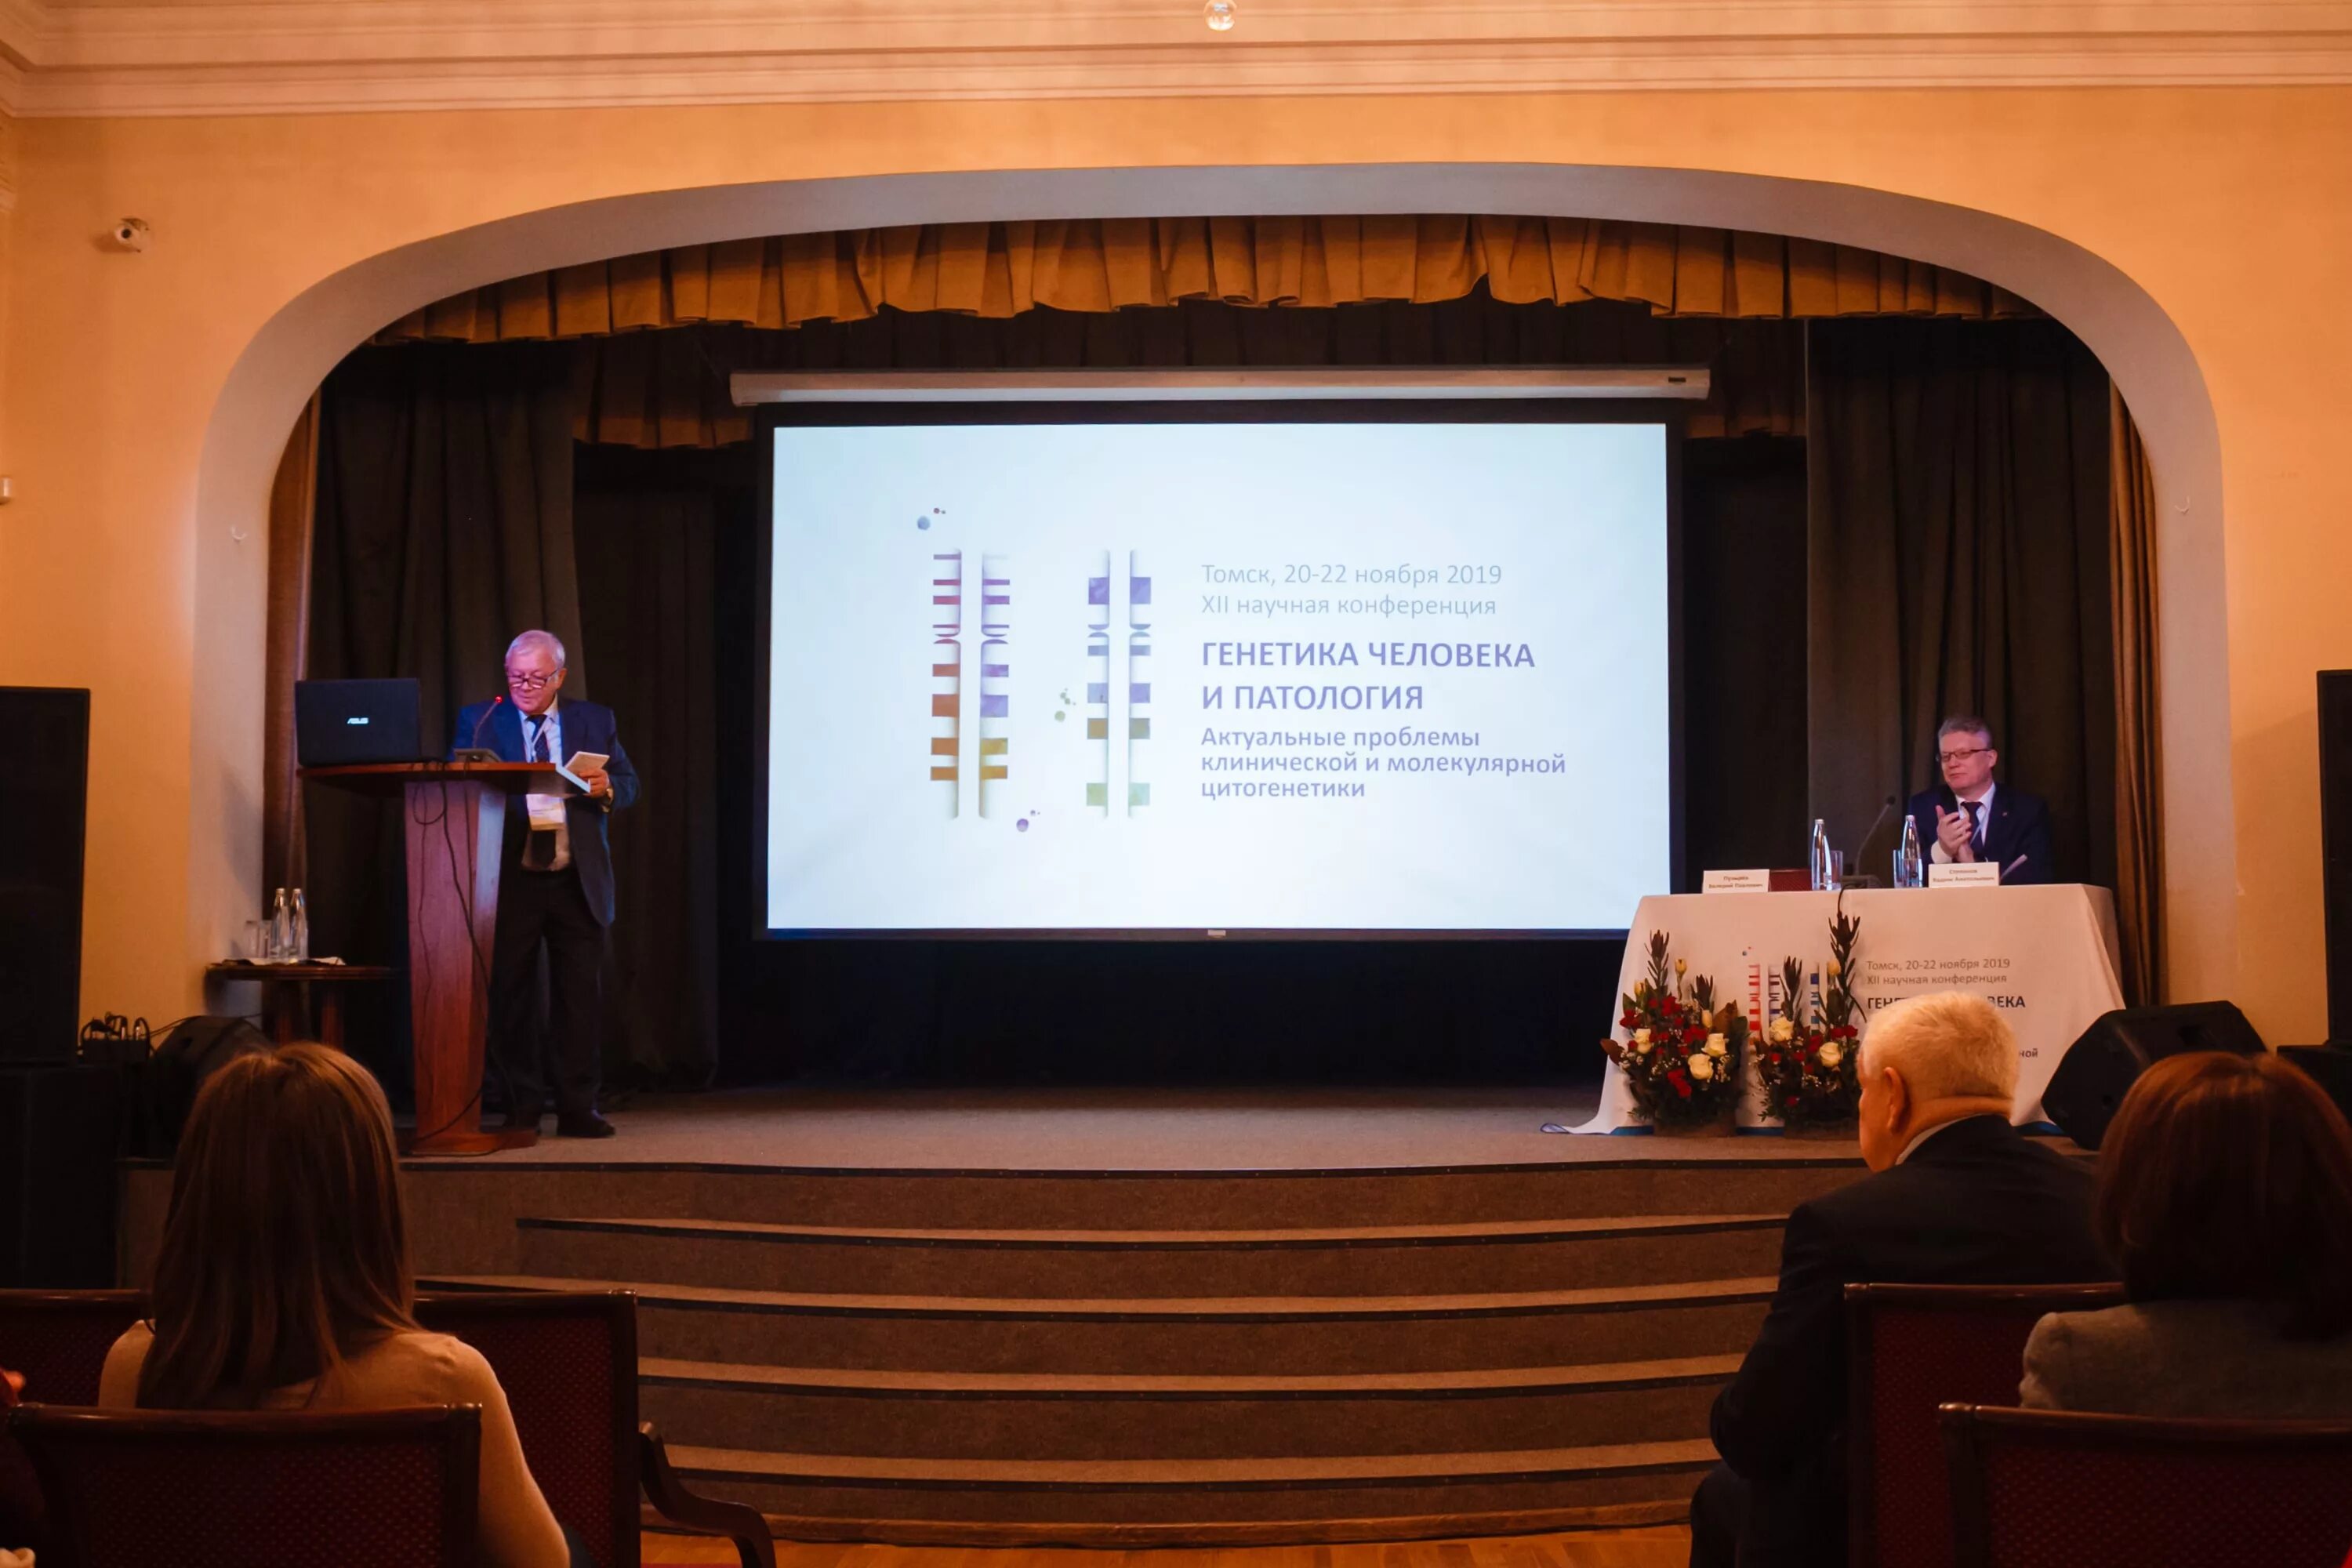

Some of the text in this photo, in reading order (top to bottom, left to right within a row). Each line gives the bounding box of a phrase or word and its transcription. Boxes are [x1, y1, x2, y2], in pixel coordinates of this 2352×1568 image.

[1201, 564, 1502, 588] Томск, 20-22 ноября 2019
[1237, 597, 1329, 618] научная
[1338, 594, 1496, 619] конференция
[1203, 643, 1535, 667] ГЕНЕТИКА ЧЕЛОВЕКА
[1203, 685, 1423, 709] И ПАТОЛОГИЯ
[1201, 727, 1479, 750] Актуальные проблемы
[1202, 752, 1566, 776] клинической и молекулярной
[1202, 782, 1365, 800] цитогенетики
[1867, 959, 2010, 971] Томск, 20-22 ноября 2019
[1883, 977, 1928, 985] научная
[1932, 974, 2006, 985] конференция
[1867, 997, 1907, 1009] ГЕН
